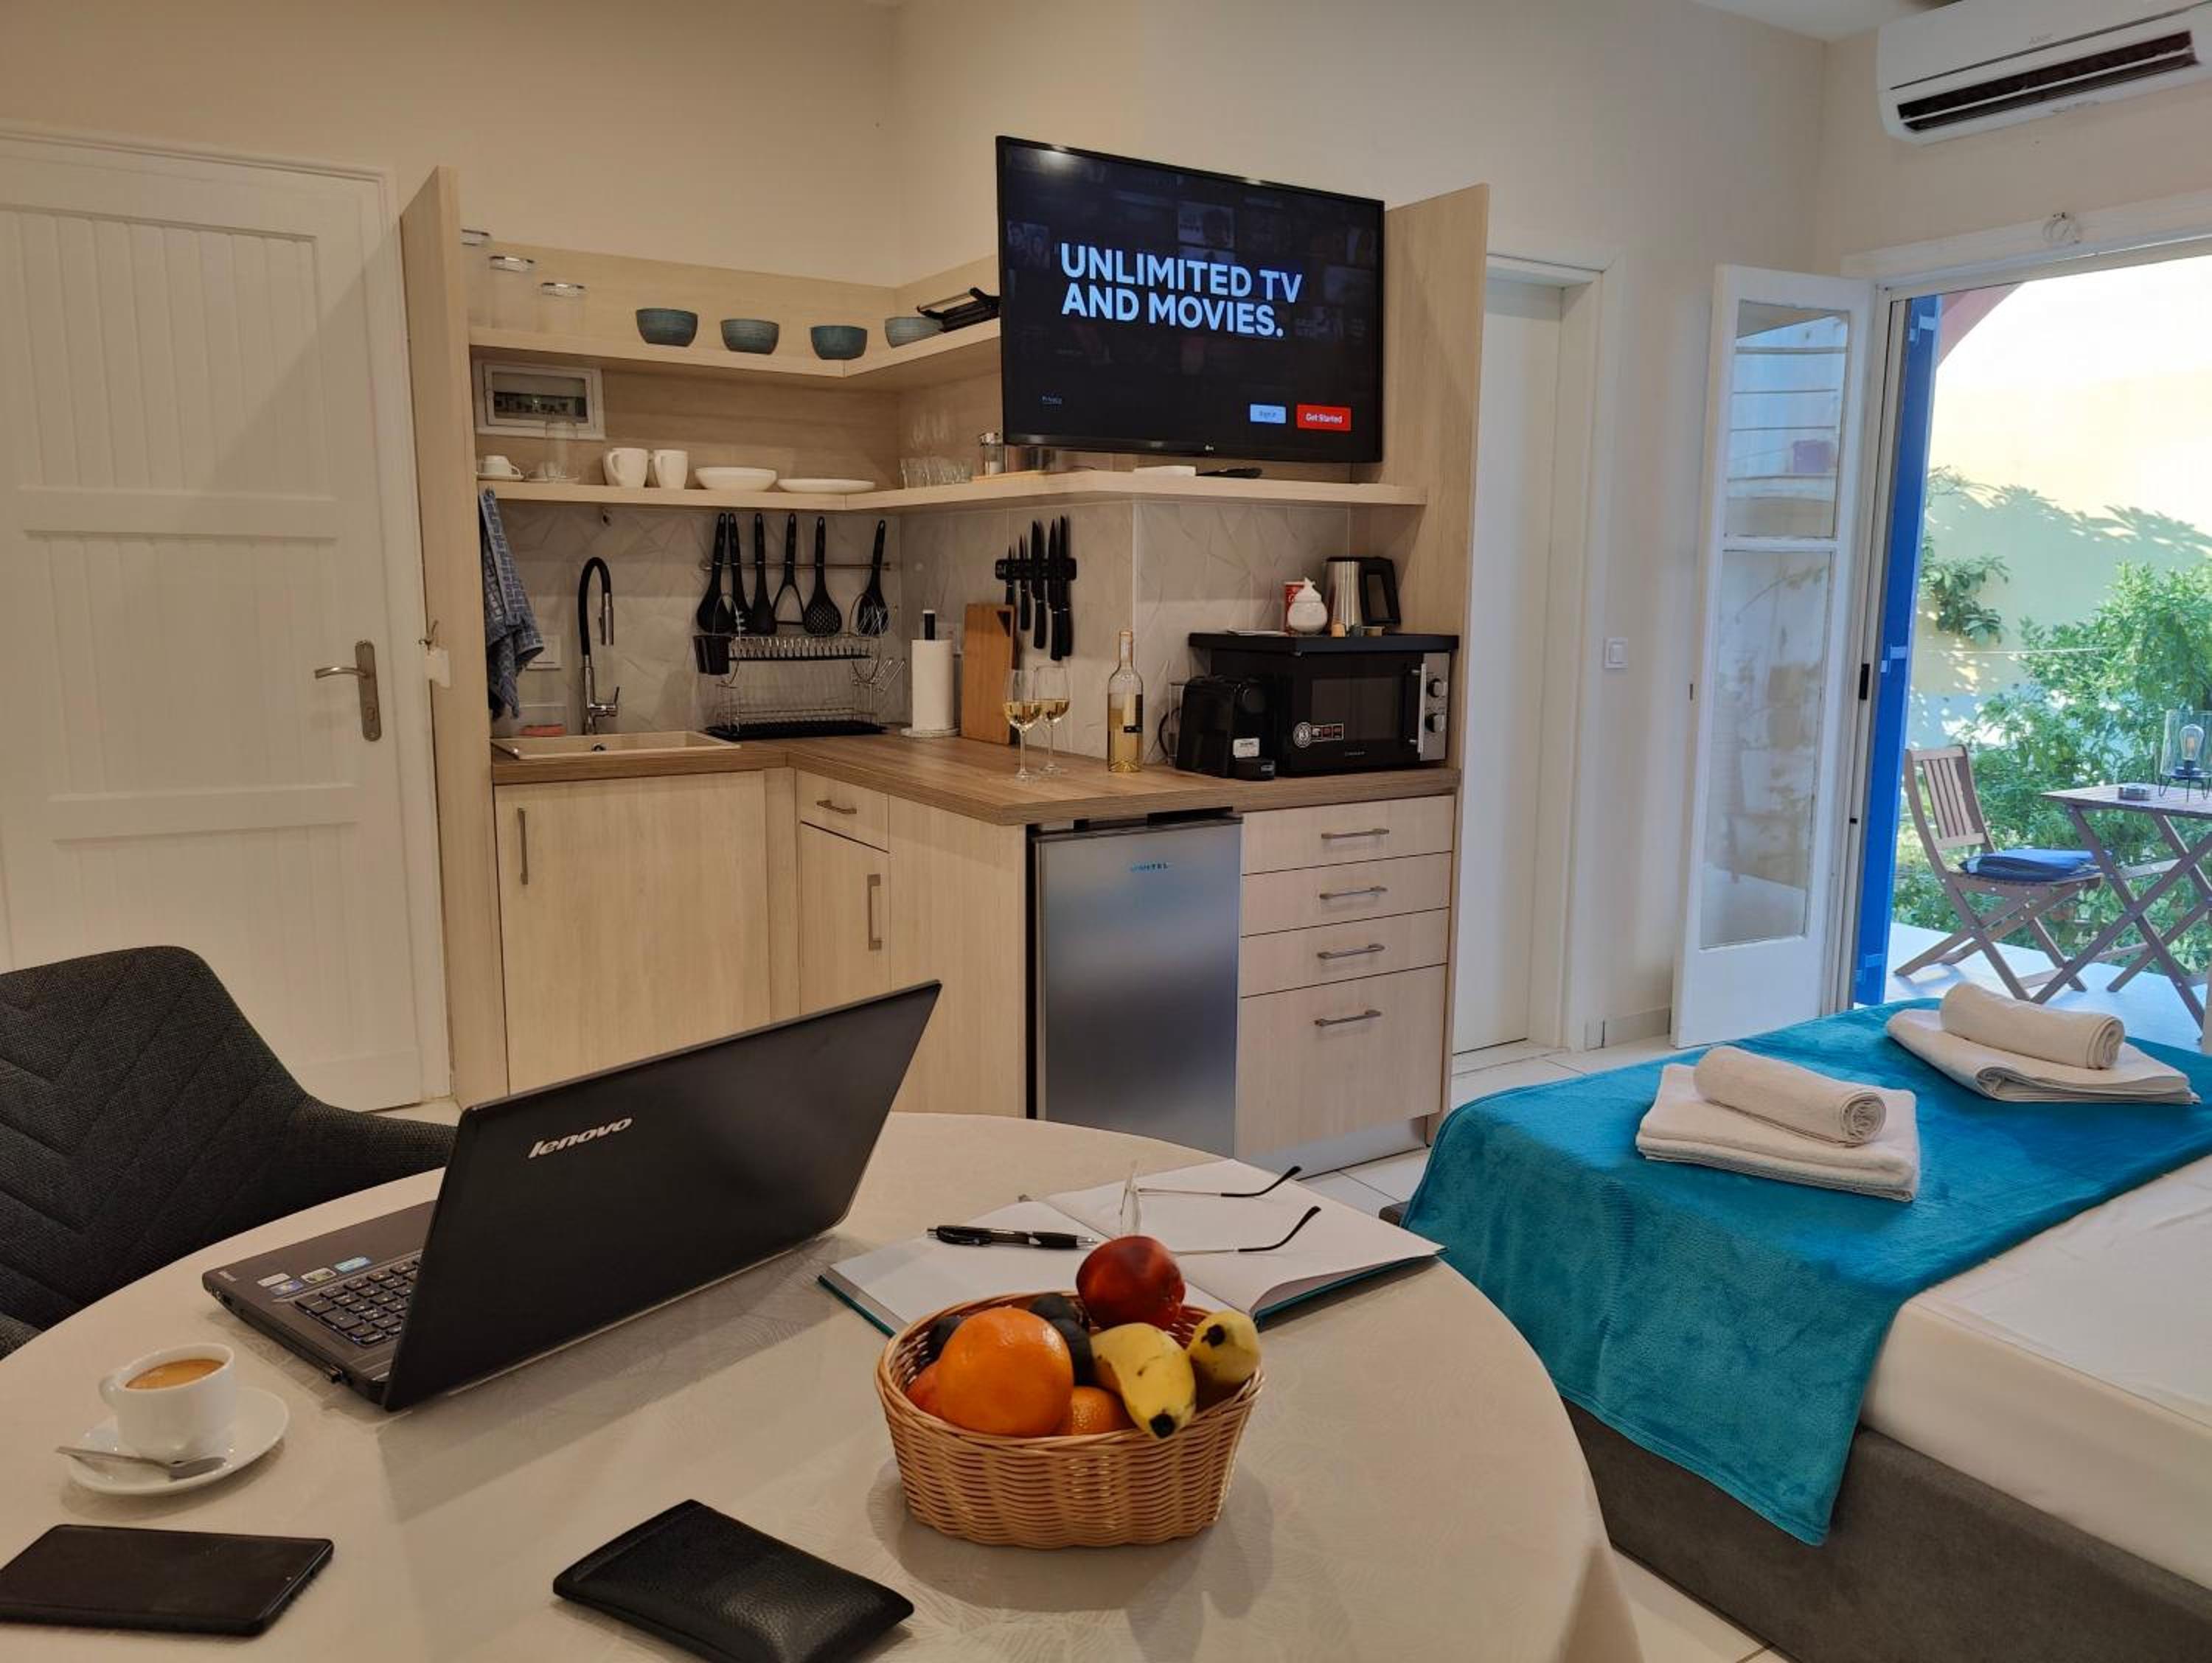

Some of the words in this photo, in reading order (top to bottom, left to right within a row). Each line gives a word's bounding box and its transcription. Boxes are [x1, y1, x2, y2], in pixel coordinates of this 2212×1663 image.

[1061, 243, 1252, 297] UNLIMITED
[1259, 269, 1302, 303] TV
[1062, 282, 1139, 321] AND
[1148, 293, 1284, 338] MOVIES.
